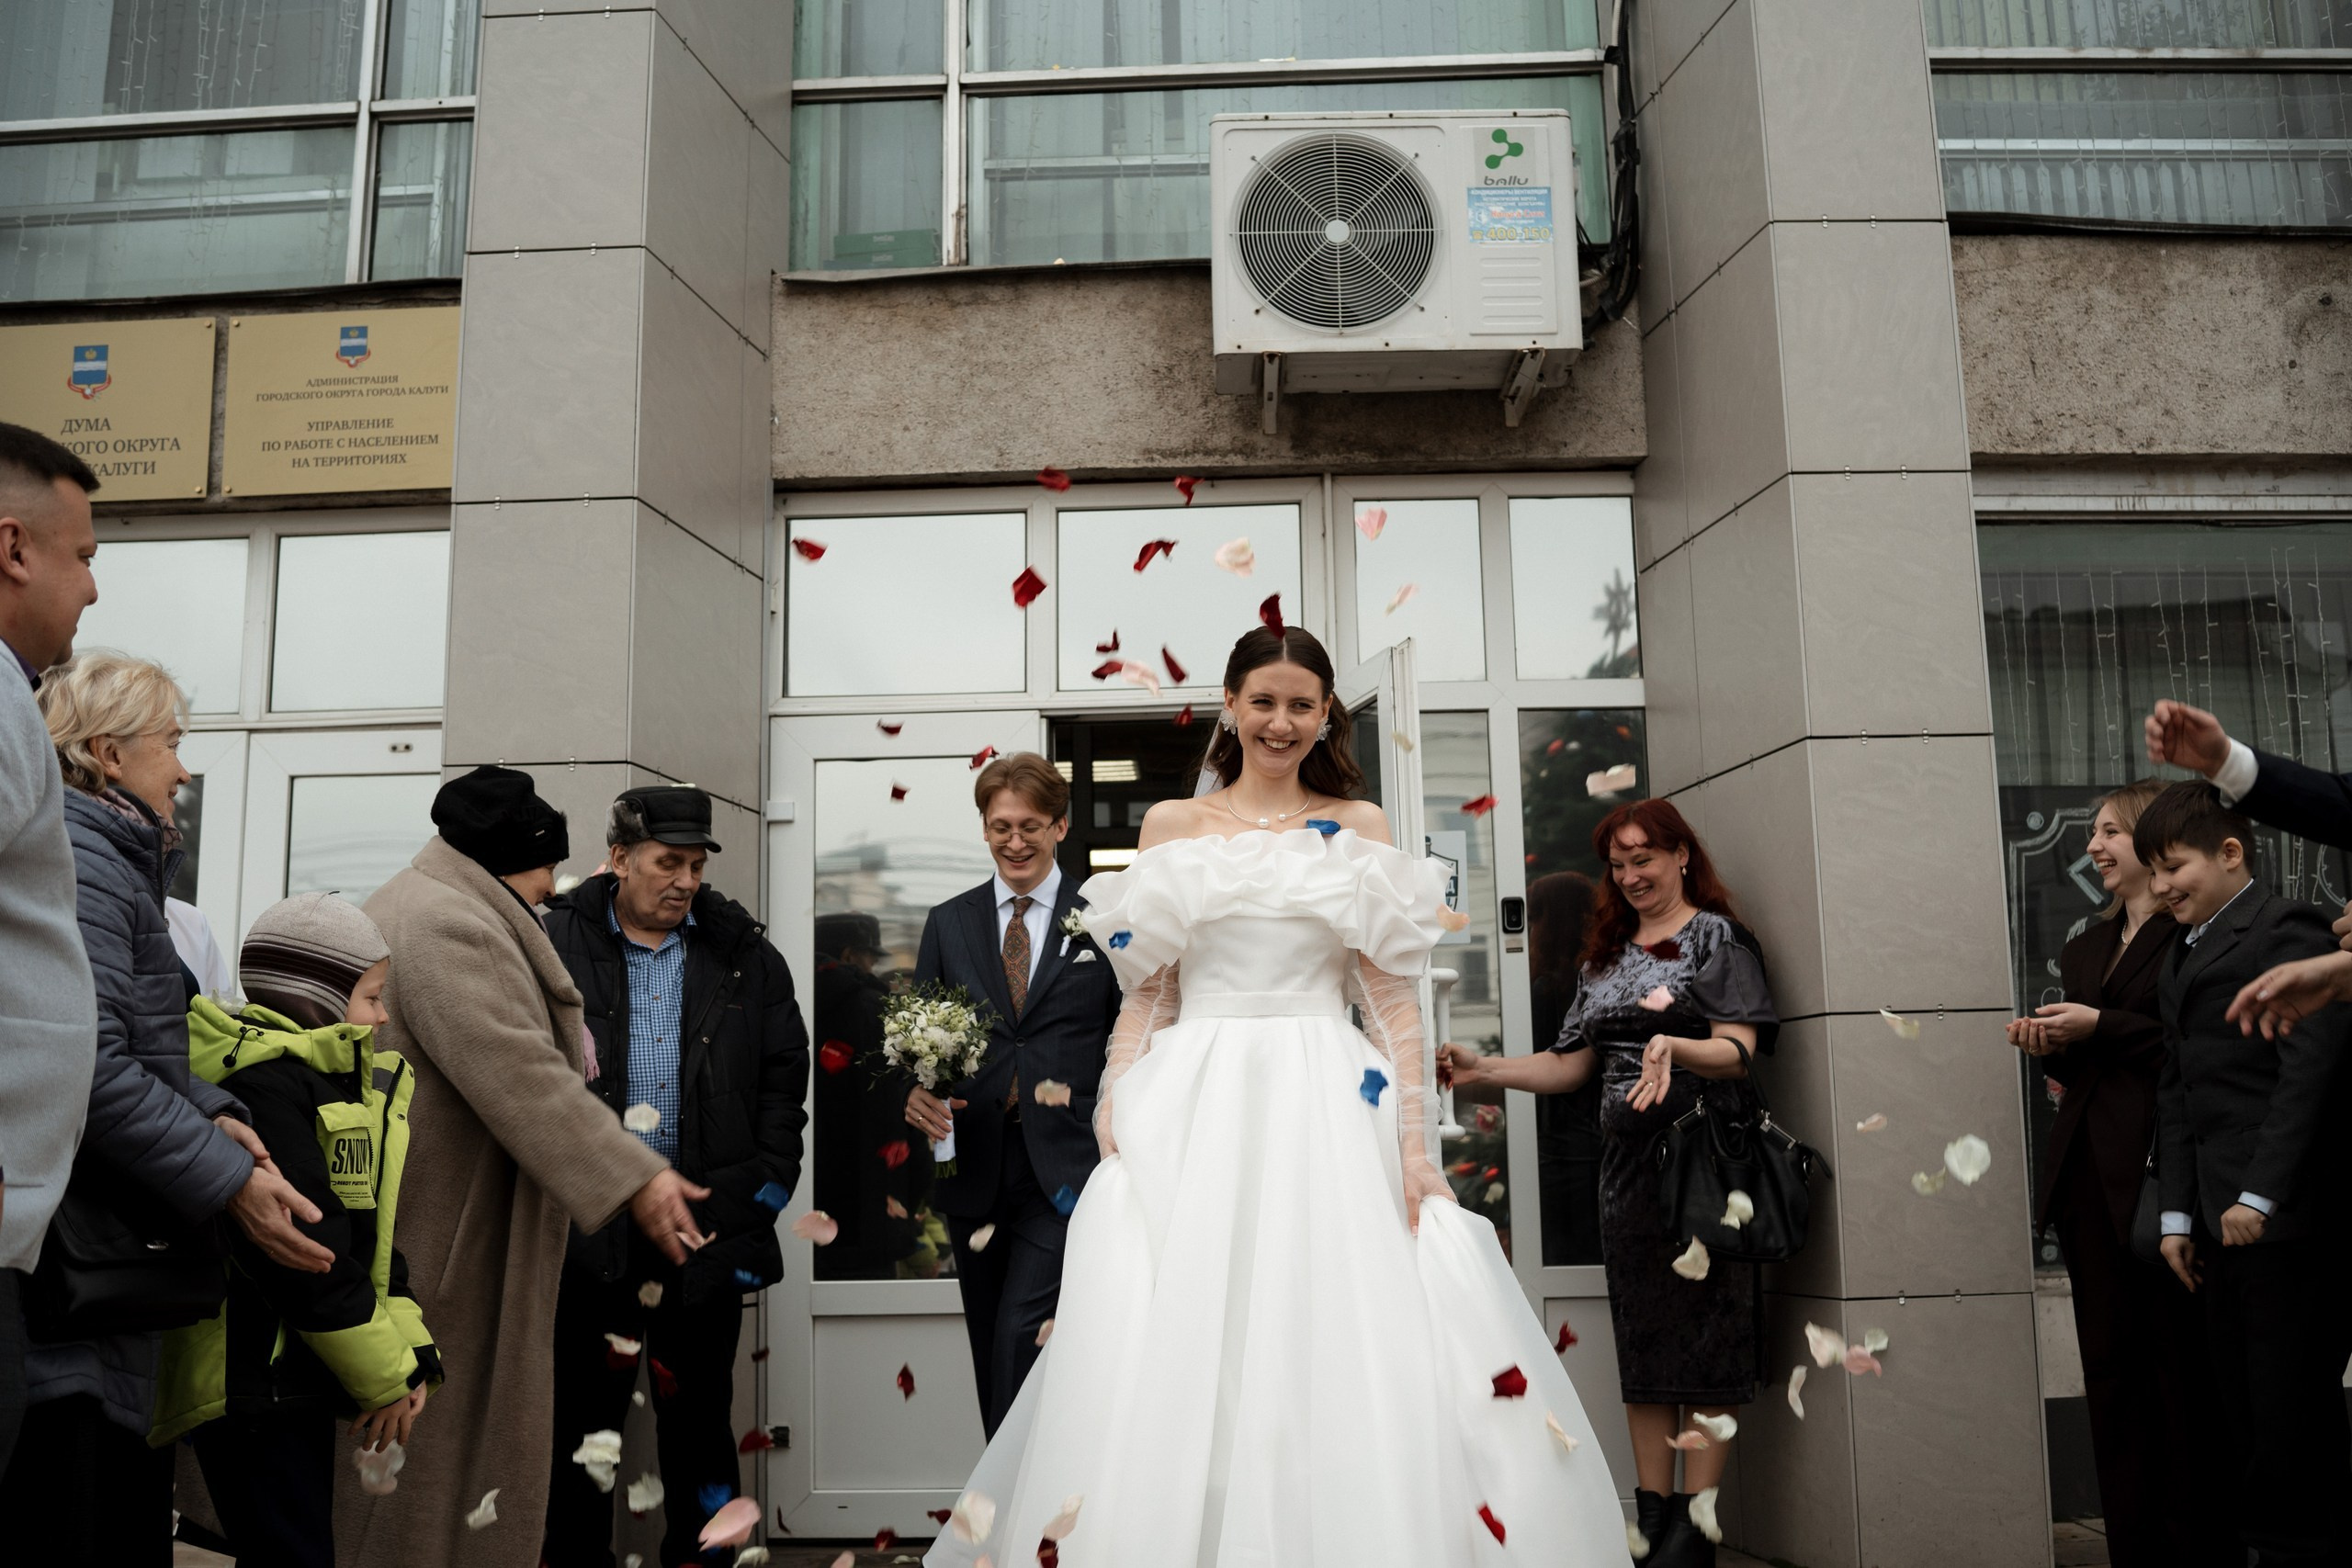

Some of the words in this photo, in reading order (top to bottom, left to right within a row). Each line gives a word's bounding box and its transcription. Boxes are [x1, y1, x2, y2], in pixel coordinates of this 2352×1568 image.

[1484, 175, 1529, 186] ballu
[1487, 227, 1551, 240] 400-150
[306, 375, 399, 388] АДМИНИСТРАЦИЯ
[256, 389, 323, 402] ГОРОДСКОГО
[325, 388, 364, 400] ОКРУГА
[366, 387, 406, 398] ГОРОДА
[409, 385, 449, 396] КАЛУГИ
[61, 417, 111, 435] ДУМА
[307, 418, 394, 433] УПРАВЛЕНИЕ
[113, 437, 181, 454] ОКРУГА
[262, 441, 281, 452] ПО
[284, 437, 334, 451] РАБОТЕ
[336, 437, 345, 449] С
[348, 434, 439, 448] НАСЕЛЕНИЕМ
[291, 457, 311, 468] НА
[312, 453, 407, 468] ТЕРРИТОРИЯХ
